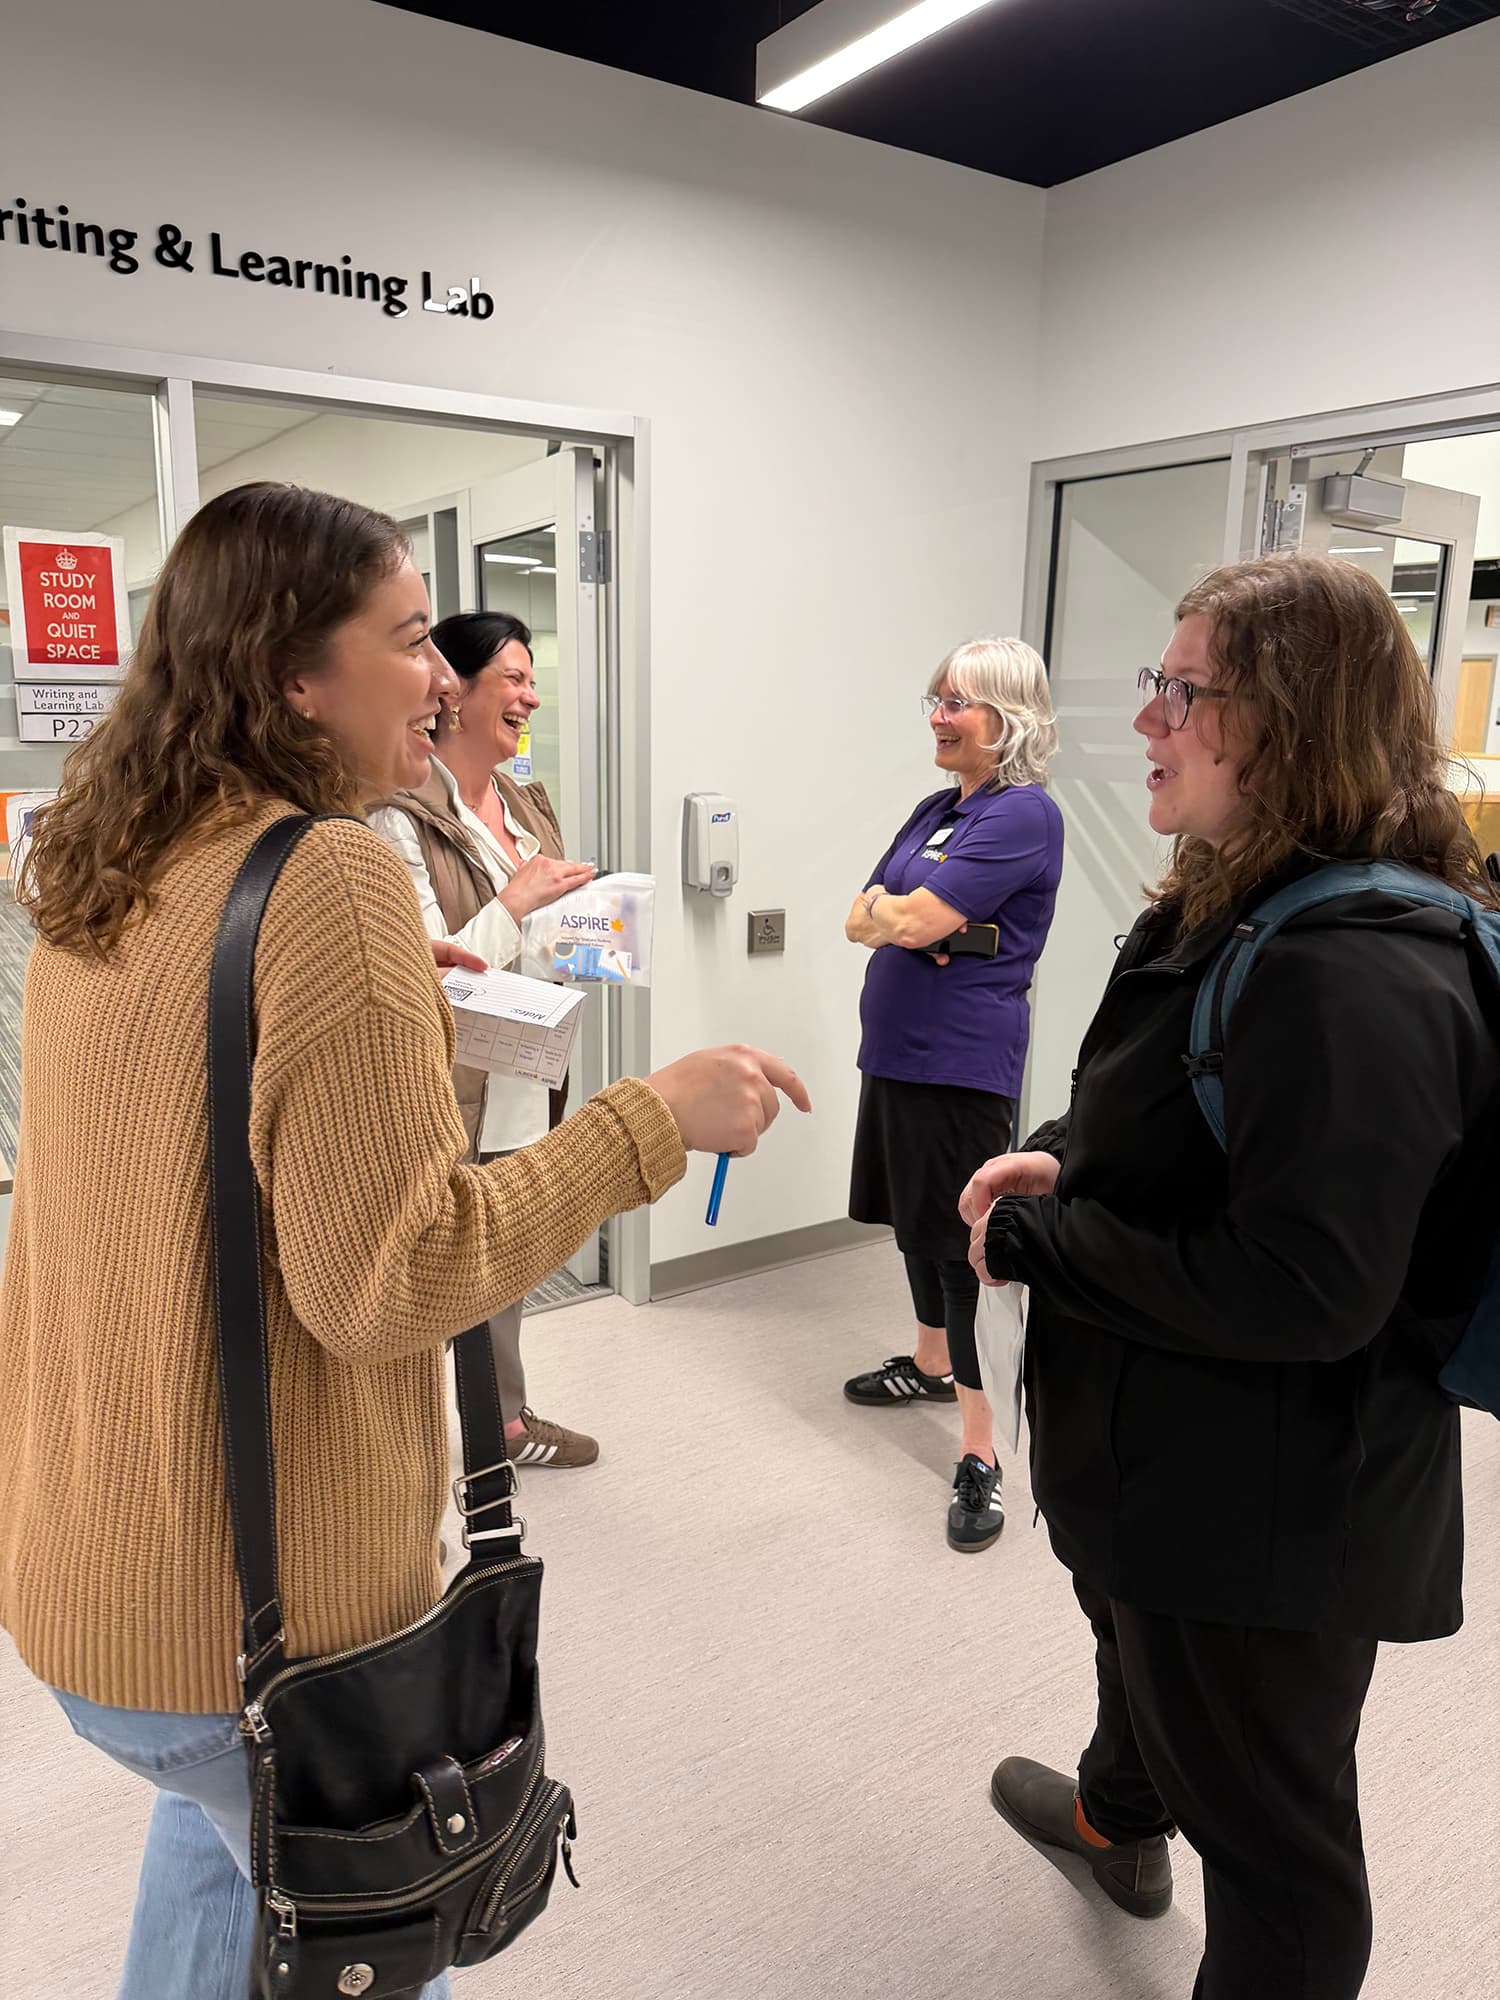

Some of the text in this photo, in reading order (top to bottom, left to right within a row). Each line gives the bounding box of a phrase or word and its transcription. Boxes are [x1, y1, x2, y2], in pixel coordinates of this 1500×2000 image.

[154, 223, 194, 273] &
[209, 232, 408, 318] Learning
[421, 271, 495, 320] Lab
[40, 572, 96, 589] STUDY
[43, 593, 96, 609] ROOM
[62, 612, 80, 620] AND
[47, 623, 96, 639] QUIET
[47, 644, 101, 660] SPACE
[32, 688, 98, 701] Writing and
[34, 700, 104, 712] Learning Lab
[560, 913, 610, 932] ASPIRE
